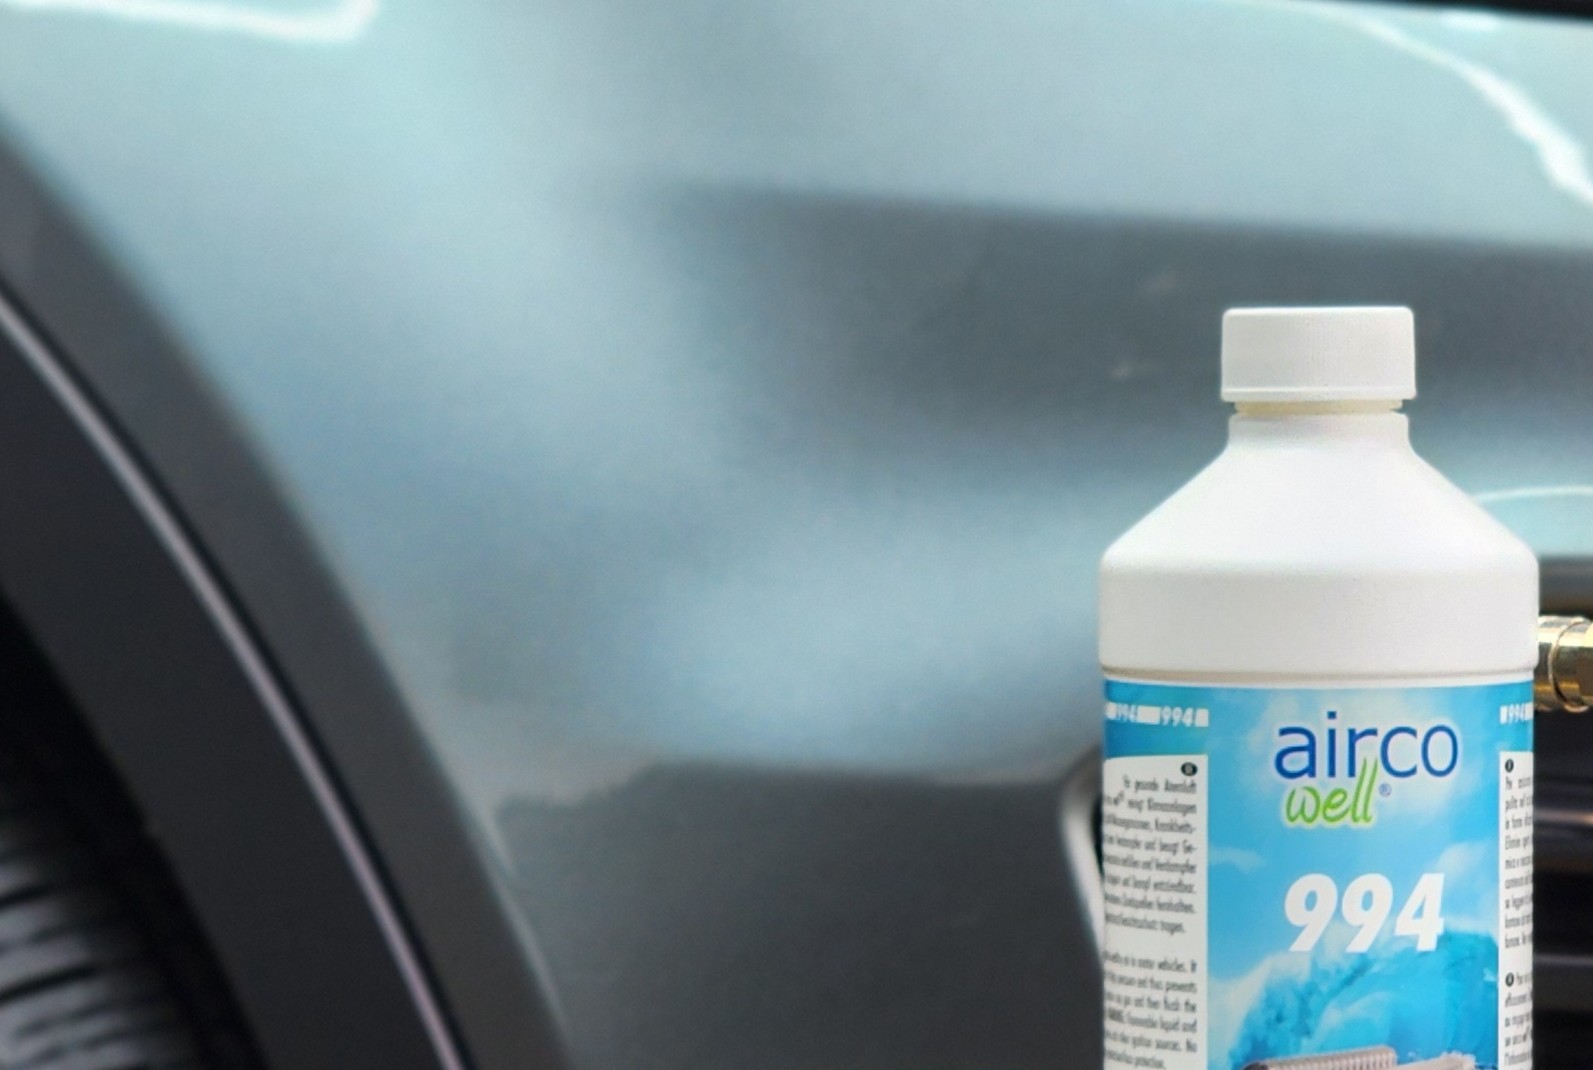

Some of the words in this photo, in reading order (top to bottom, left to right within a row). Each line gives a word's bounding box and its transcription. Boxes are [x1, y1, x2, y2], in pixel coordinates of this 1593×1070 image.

[1274, 711, 1459, 779] airco
[1285, 757, 1379, 824] well
[1284, 873, 1445, 953] 994
